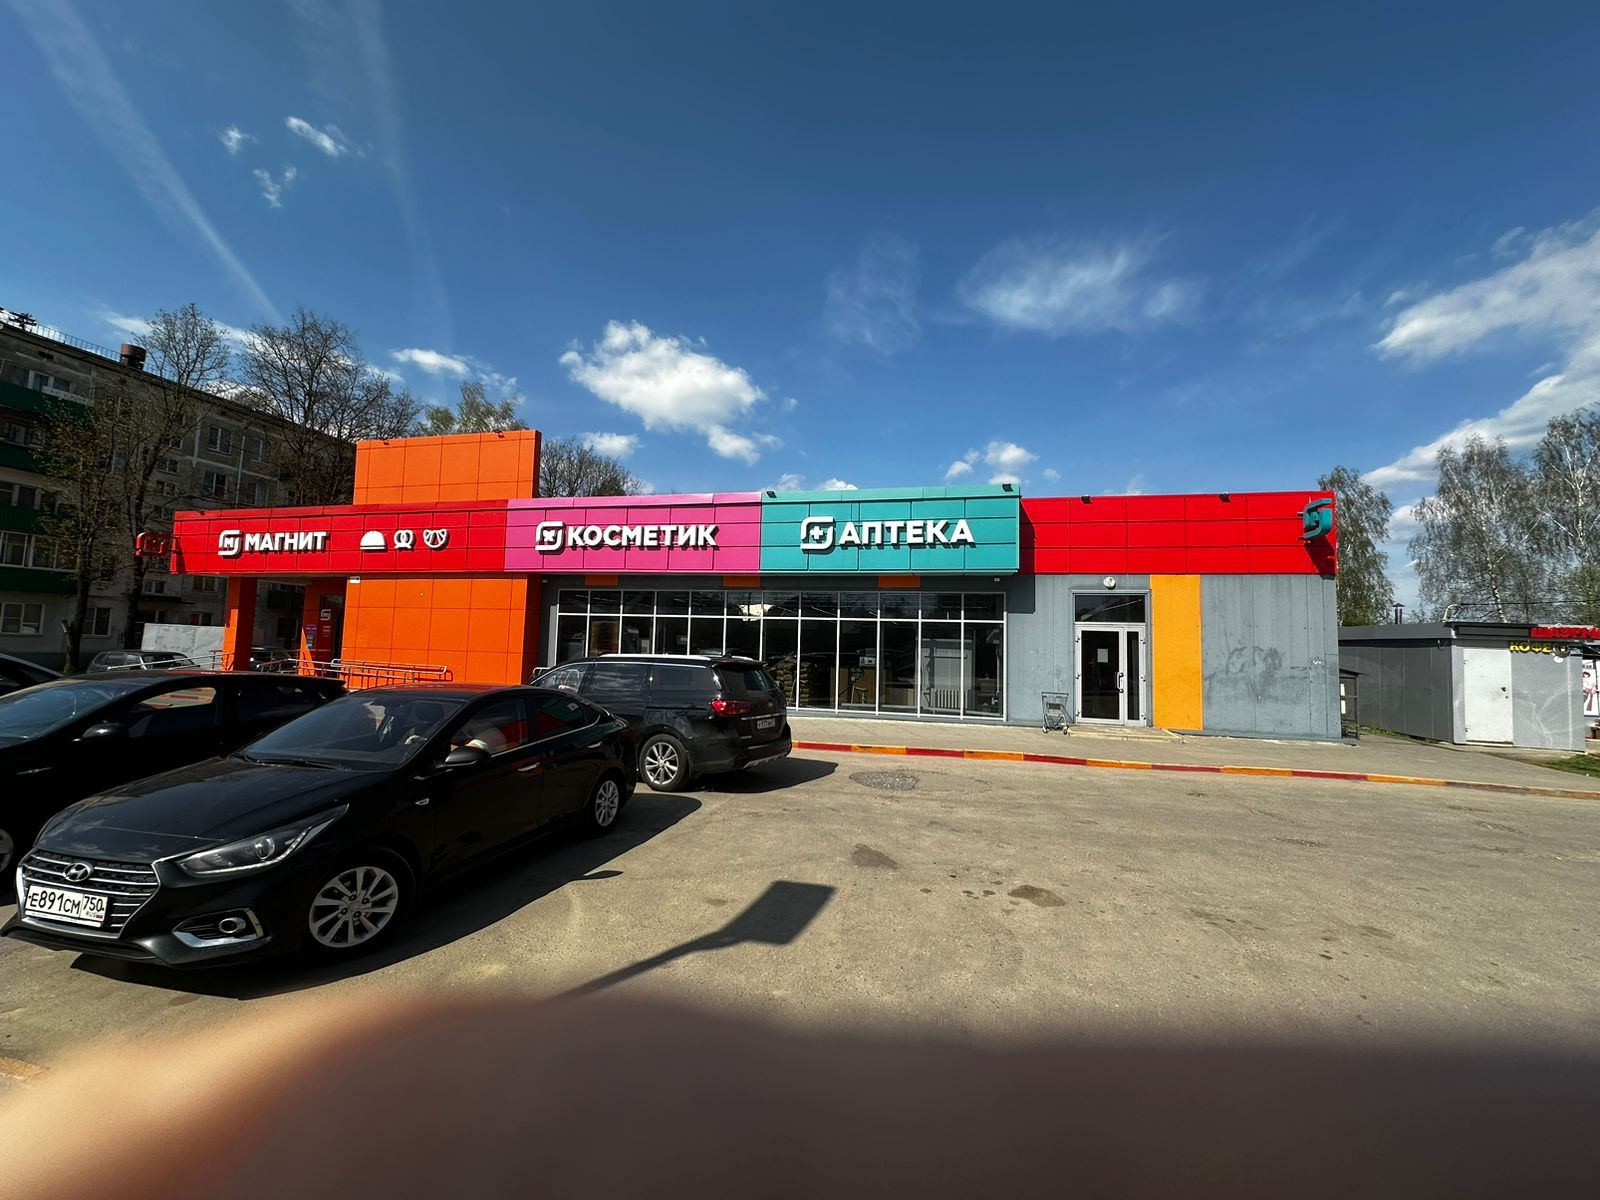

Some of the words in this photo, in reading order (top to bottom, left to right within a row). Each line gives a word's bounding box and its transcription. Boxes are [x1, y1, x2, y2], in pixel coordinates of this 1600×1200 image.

[244, 531, 327, 551] МАГНИТ
[567, 524, 718, 547] КОСМЕТИК
[838, 519, 976, 545] АПТЕКА
[1508, 641, 1552, 654] КОФЕ
[29, 890, 81, 915] Е891СМ
[83, 895, 102, 913] 750
